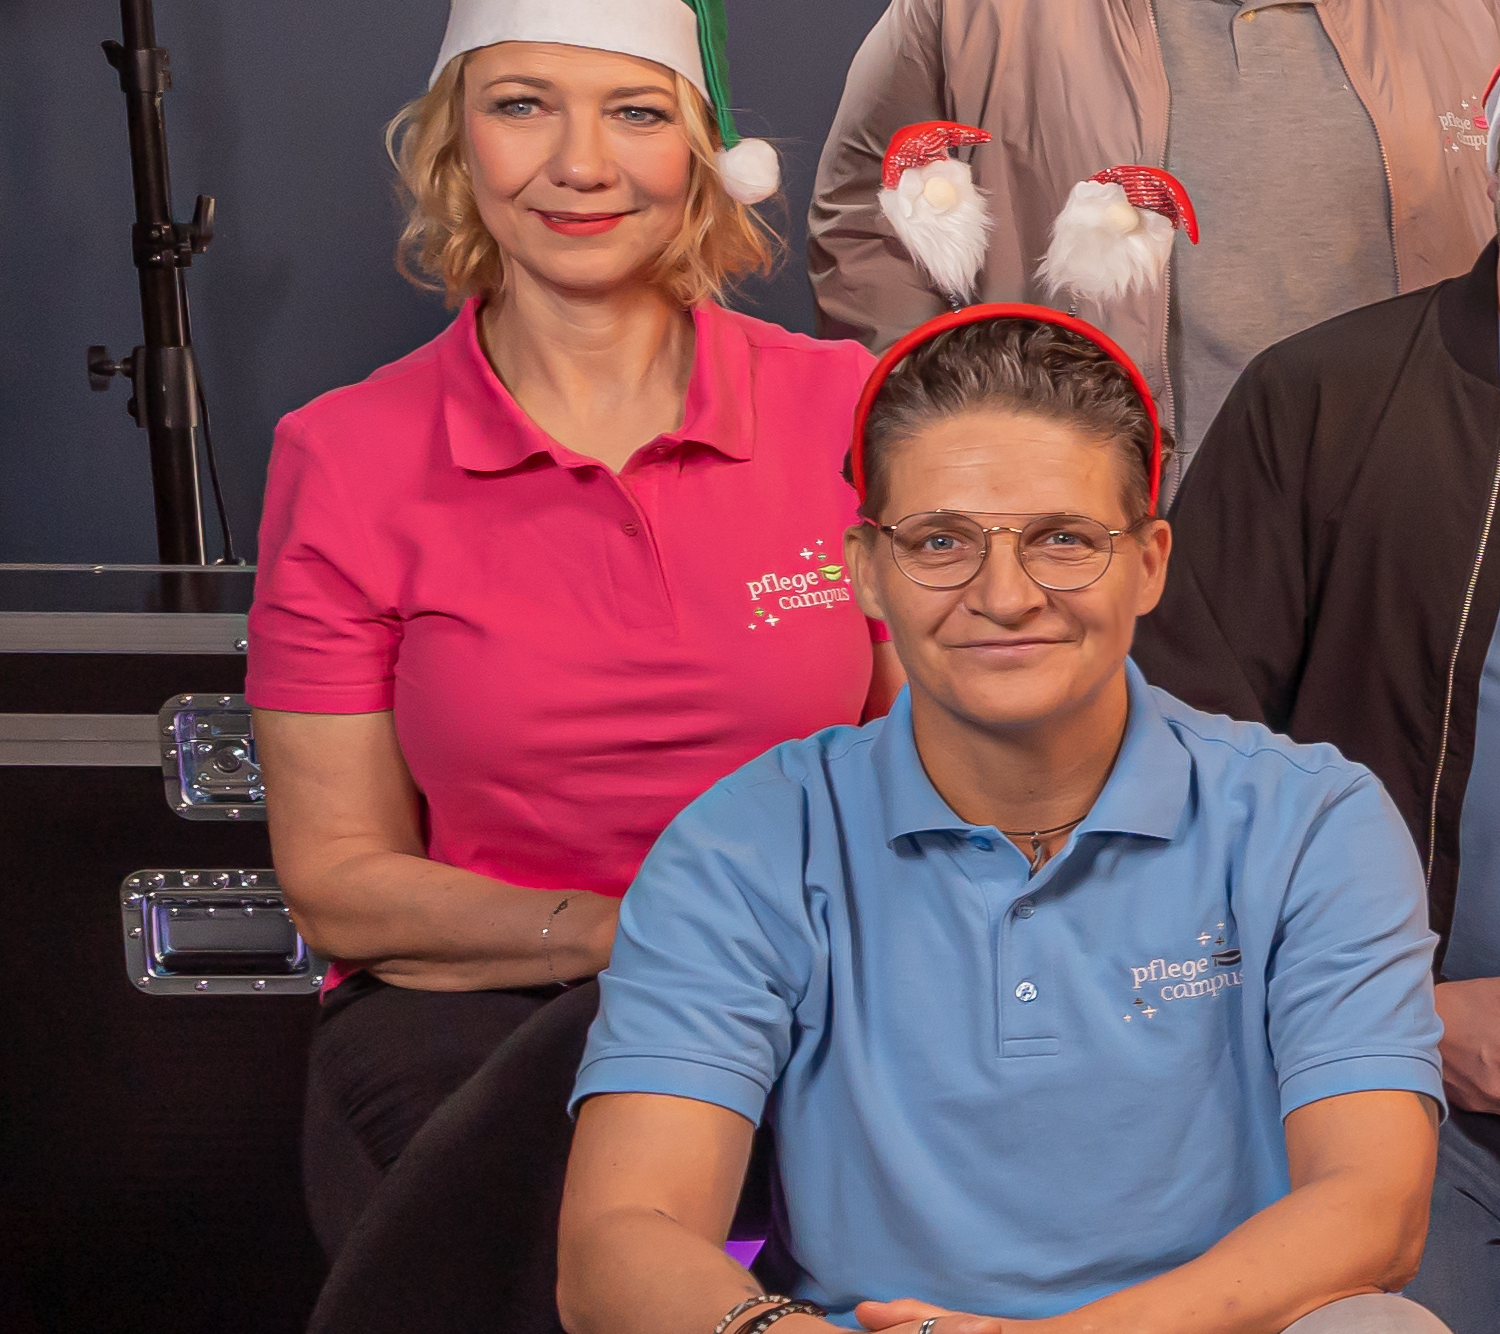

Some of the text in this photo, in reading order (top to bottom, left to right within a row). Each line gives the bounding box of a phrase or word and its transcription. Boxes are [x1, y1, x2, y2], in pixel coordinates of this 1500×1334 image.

[746, 571, 819, 601] pflege
[778, 587, 850, 610] campus
[1130, 957, 1209, 989] pflege
